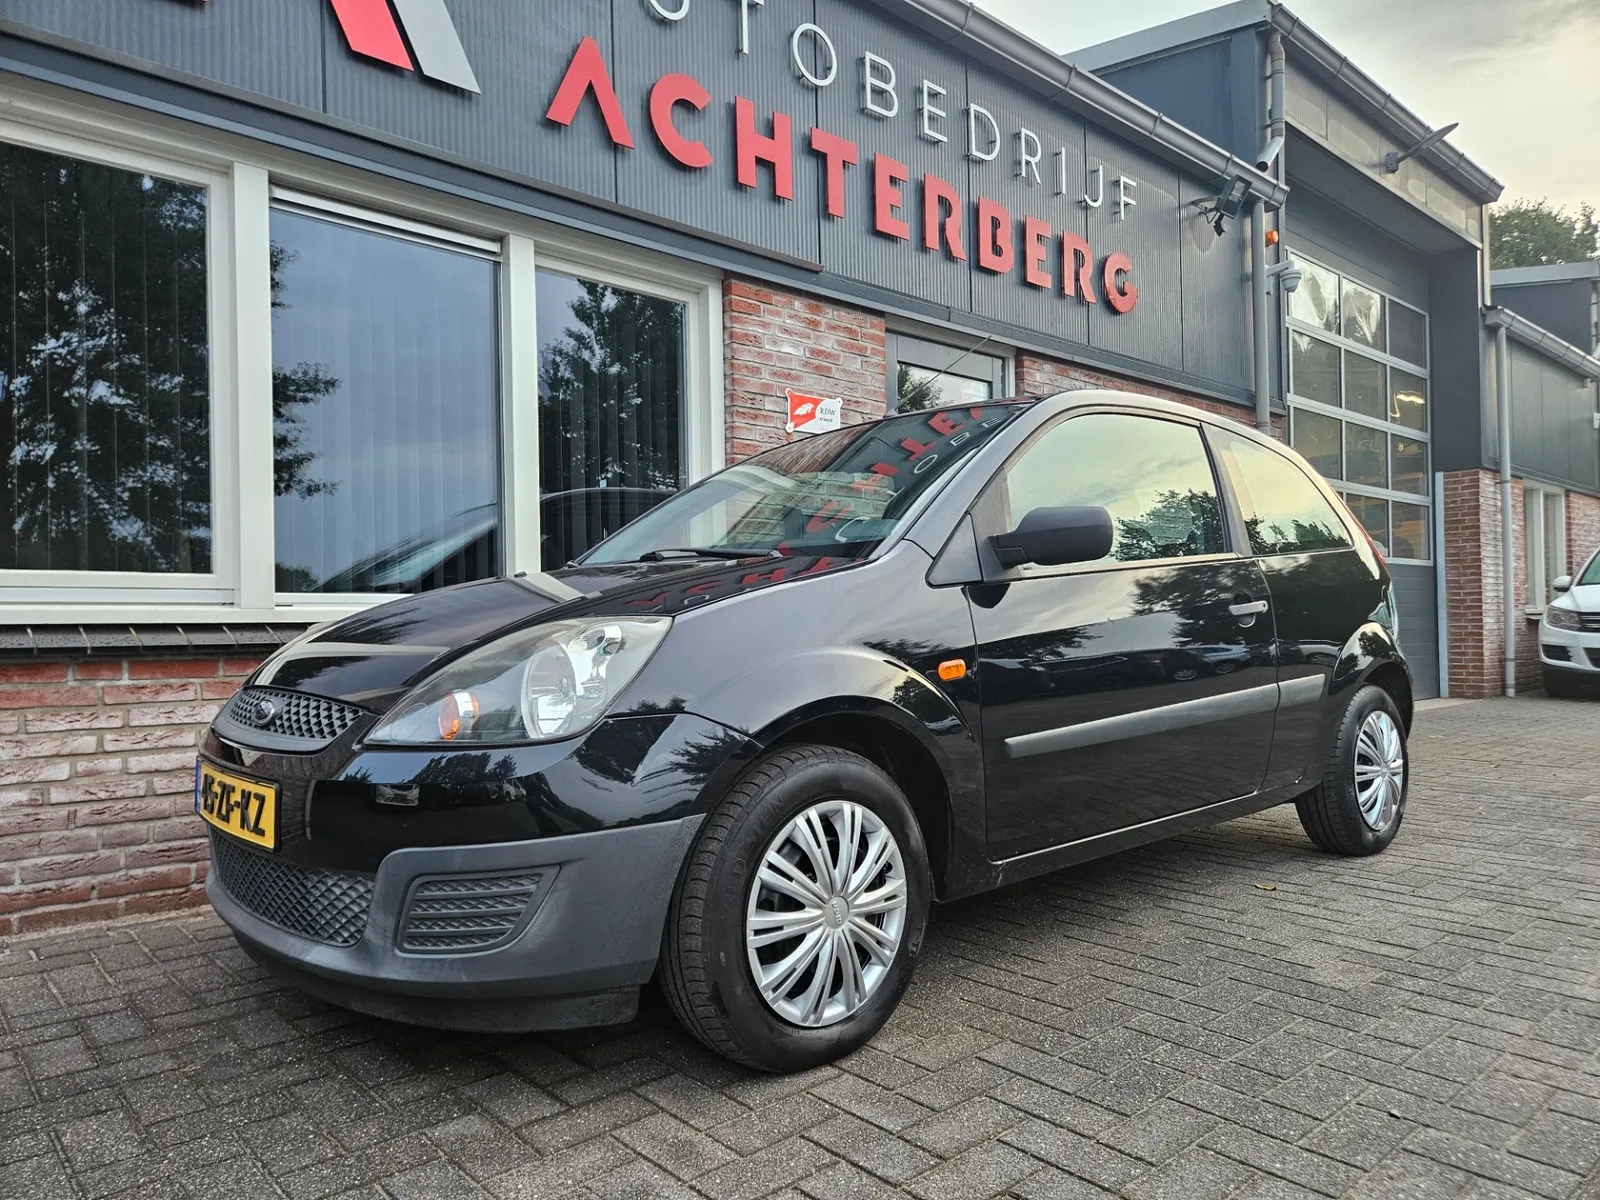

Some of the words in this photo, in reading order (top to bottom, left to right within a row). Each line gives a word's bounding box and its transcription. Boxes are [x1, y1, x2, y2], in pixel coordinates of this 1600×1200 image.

[545, 36, 1138, 314] ACHTERBERG
[650, 0, 1137, 221] TOBEDRIJF
[819, 407, 836, 416] RDW
